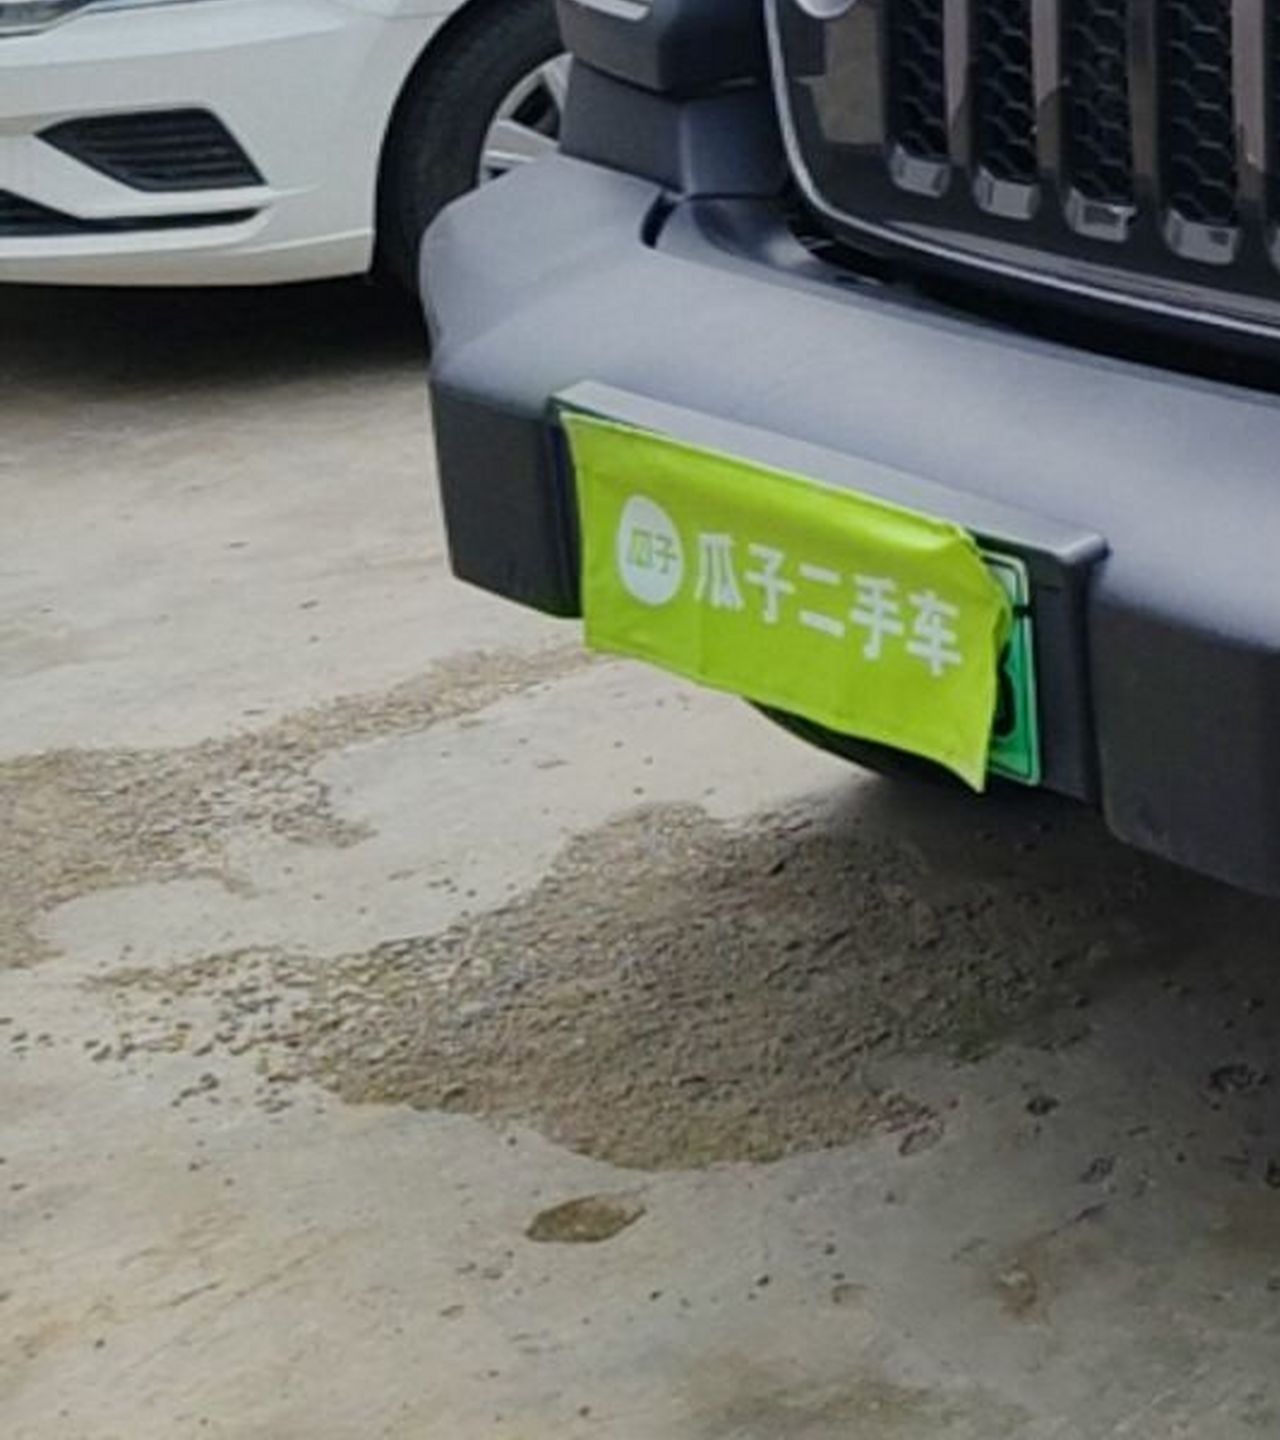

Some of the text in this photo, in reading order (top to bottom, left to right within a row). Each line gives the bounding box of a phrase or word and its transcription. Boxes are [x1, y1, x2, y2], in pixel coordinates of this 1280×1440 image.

[694, 531, 962, 677] 瓜子二手车
